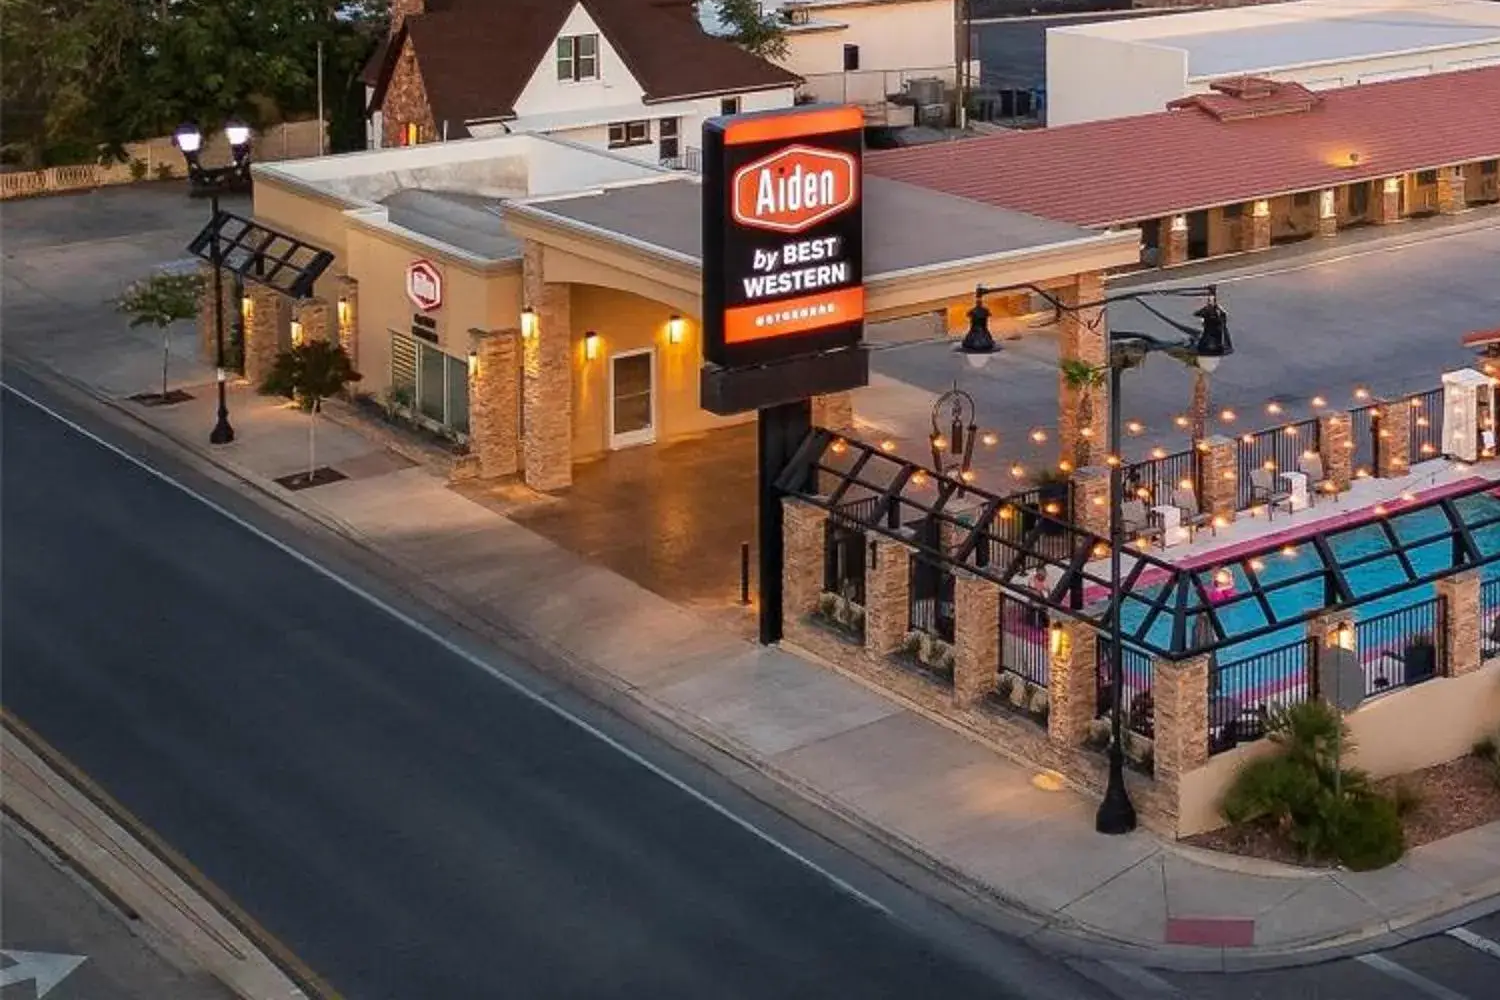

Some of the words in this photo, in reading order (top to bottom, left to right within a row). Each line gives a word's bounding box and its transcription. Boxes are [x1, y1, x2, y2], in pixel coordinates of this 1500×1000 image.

[755, 162, 835, 216] Aiden
[753, 248, 779, 273] by
[783, 237, 836, 265] BEST
[743, 263, 845, 299] WESTERN
